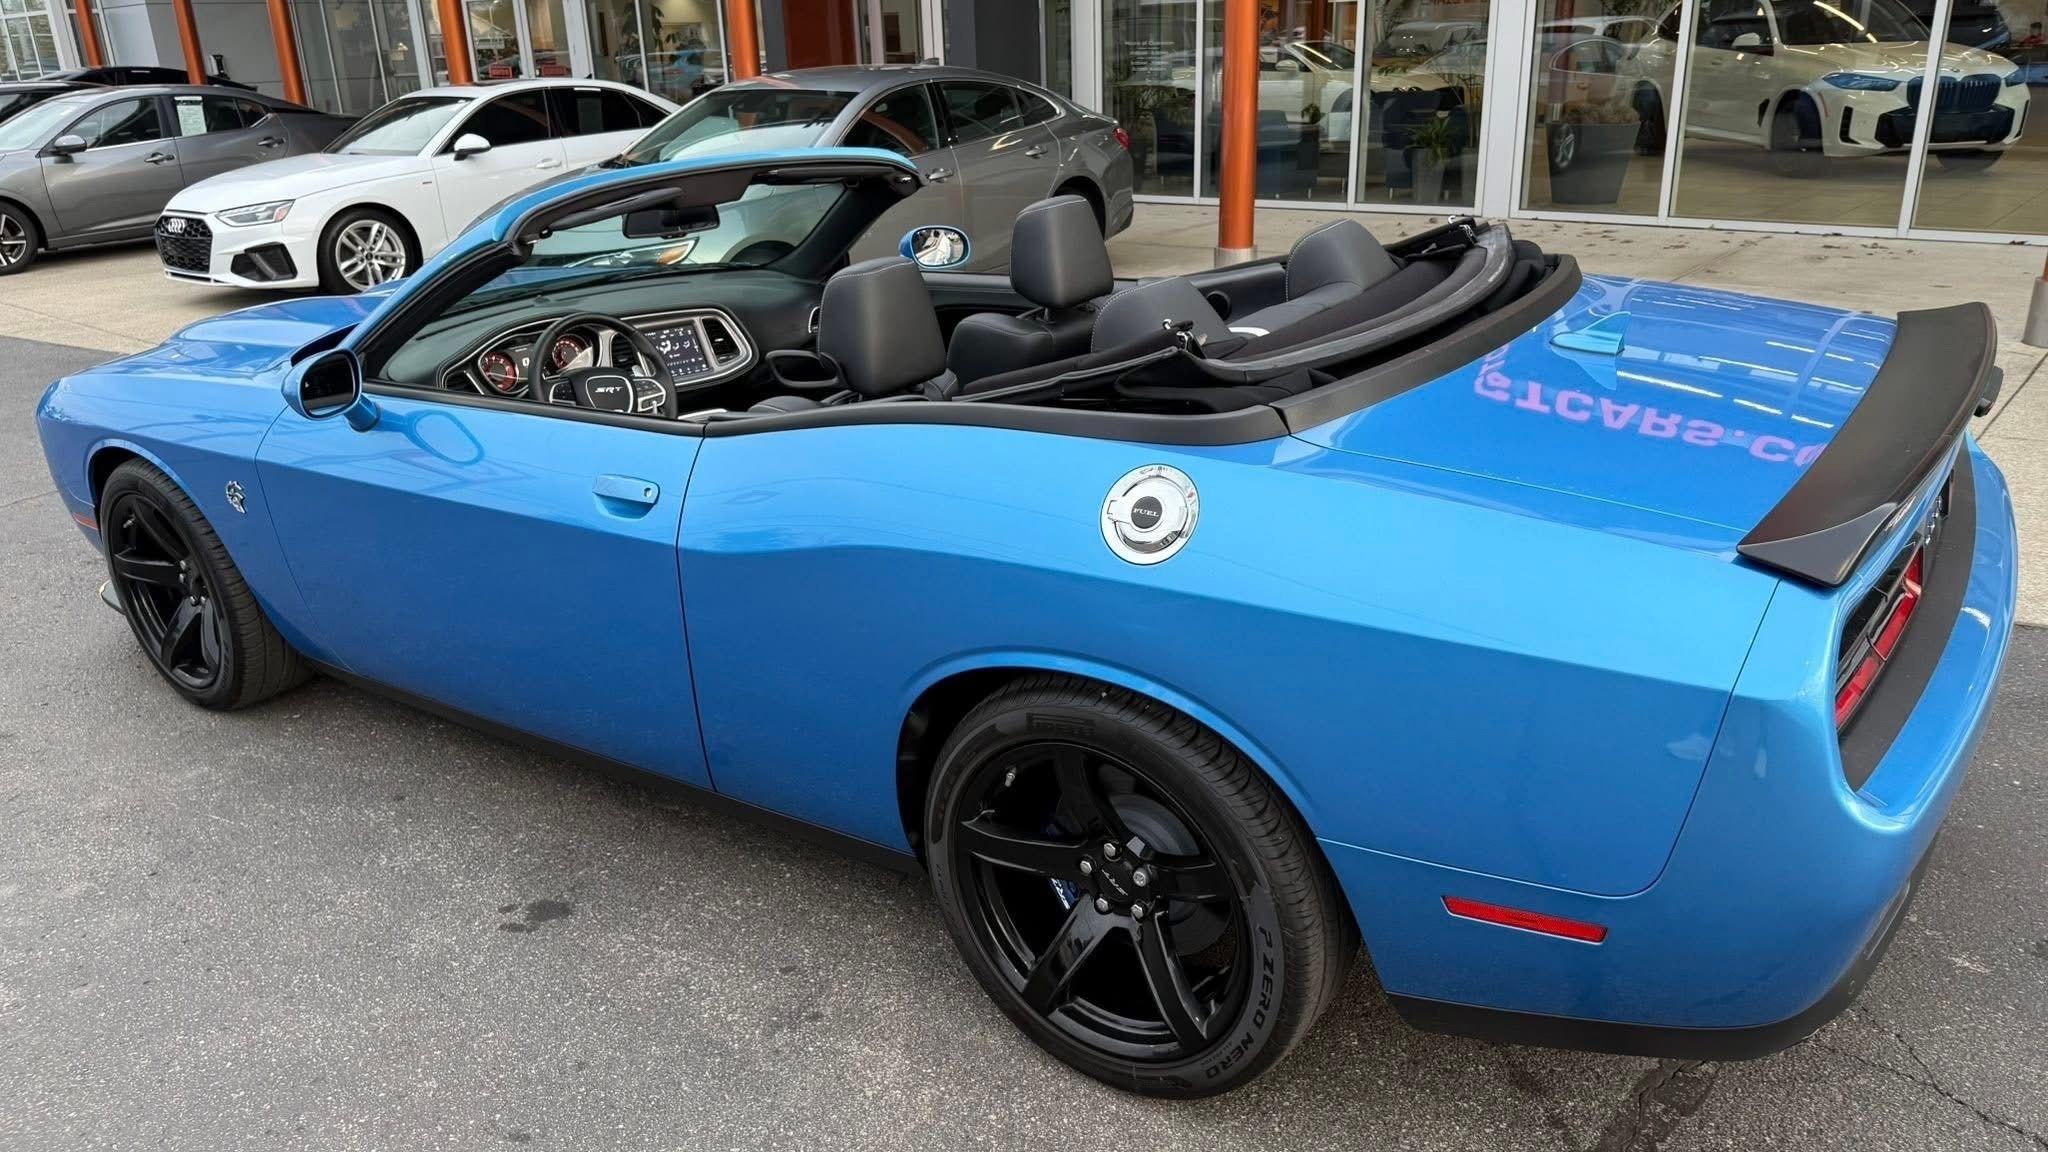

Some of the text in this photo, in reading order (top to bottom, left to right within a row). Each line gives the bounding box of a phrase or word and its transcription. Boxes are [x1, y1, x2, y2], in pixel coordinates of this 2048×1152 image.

[595, 386, 623, 394] SRT
[1132, 506, 1160, 518] FUEL
[1253, 952, 1274, 1029] ZERO
[1206, 1032, 1254, 1079] NERO
